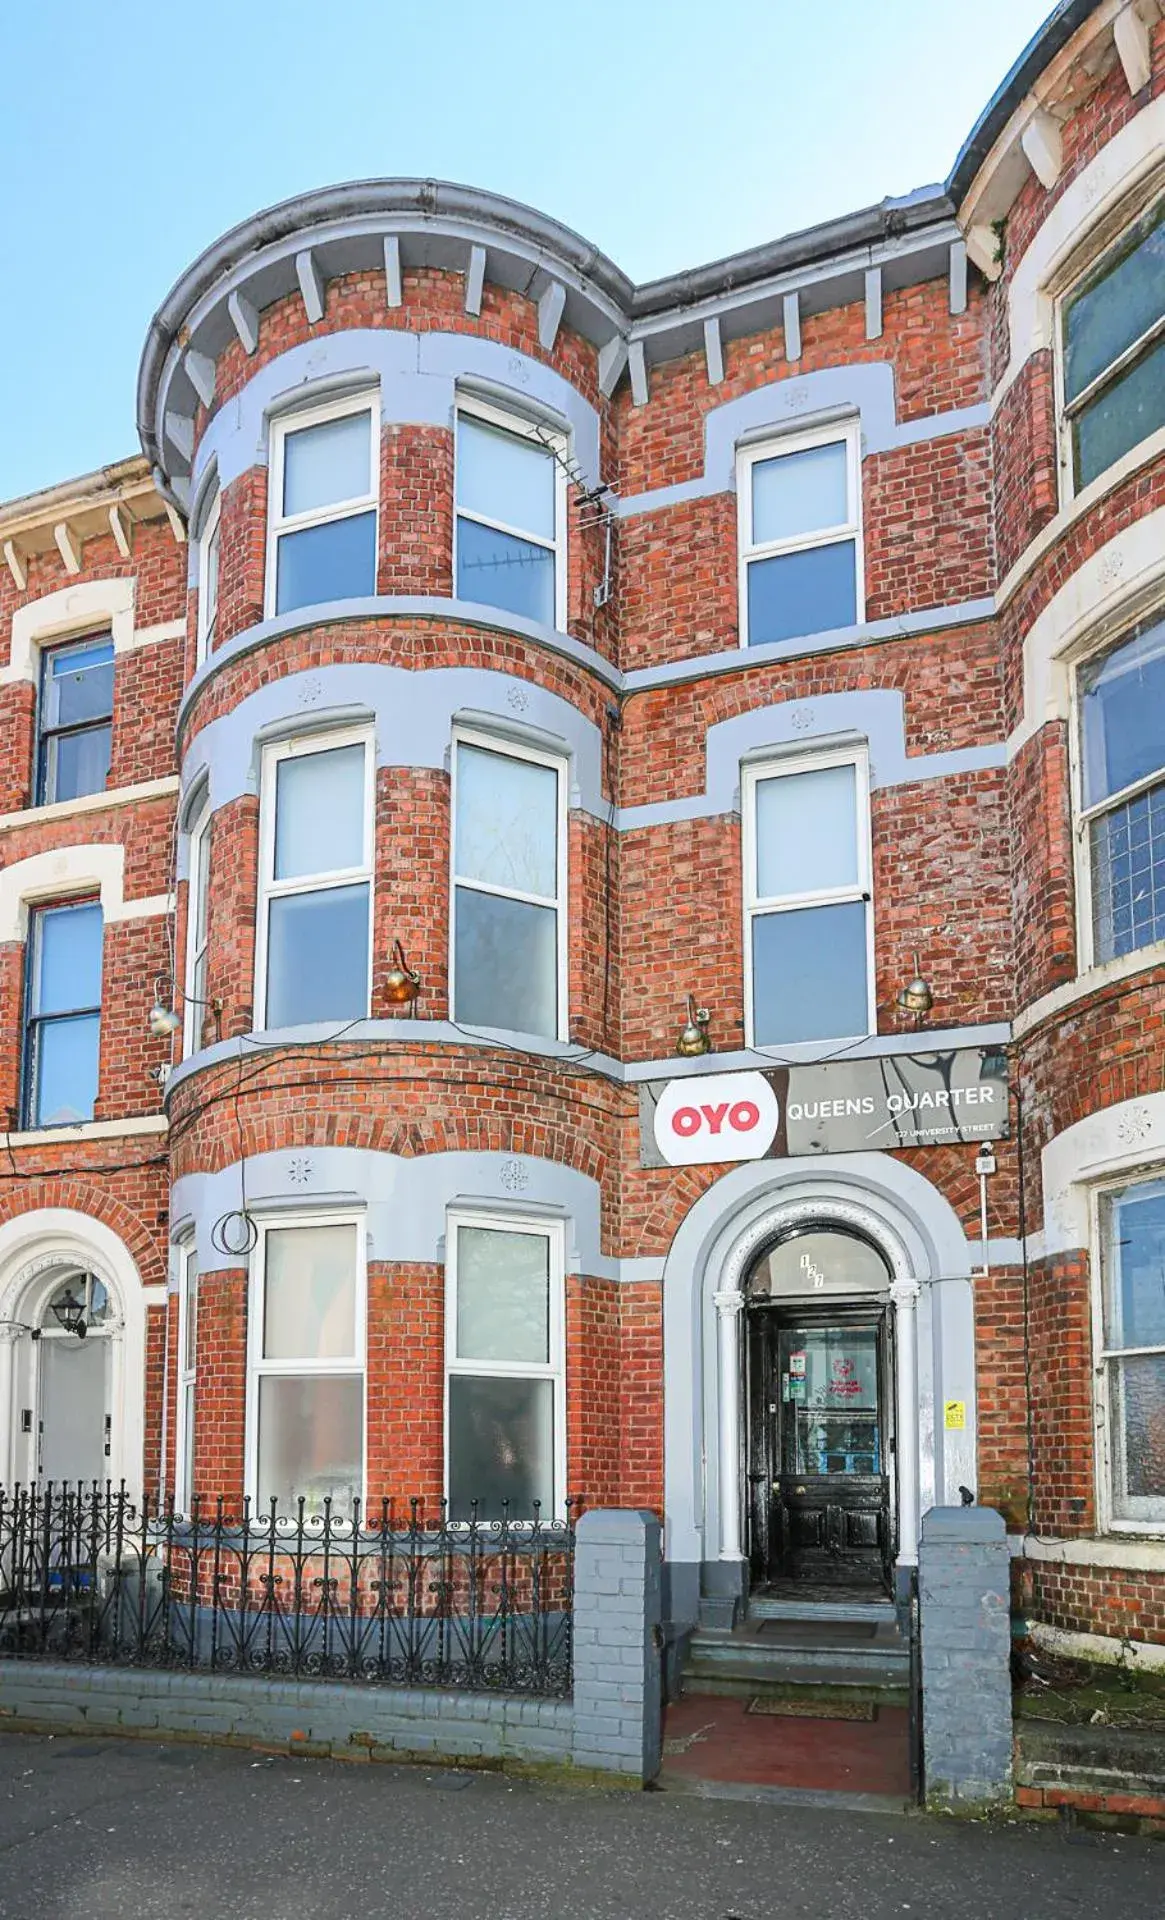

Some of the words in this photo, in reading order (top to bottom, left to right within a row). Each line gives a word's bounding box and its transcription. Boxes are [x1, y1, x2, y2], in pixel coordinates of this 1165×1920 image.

[672, 1101, 760, 1137] OYO
[788, 1098, 874, 1120] QUEENS
[887, 1087, 994, 1111] QUARTER
[909, 1127, 960, 1137] UNIVERSITY
[961, 1123, 994, 1133] STREET
